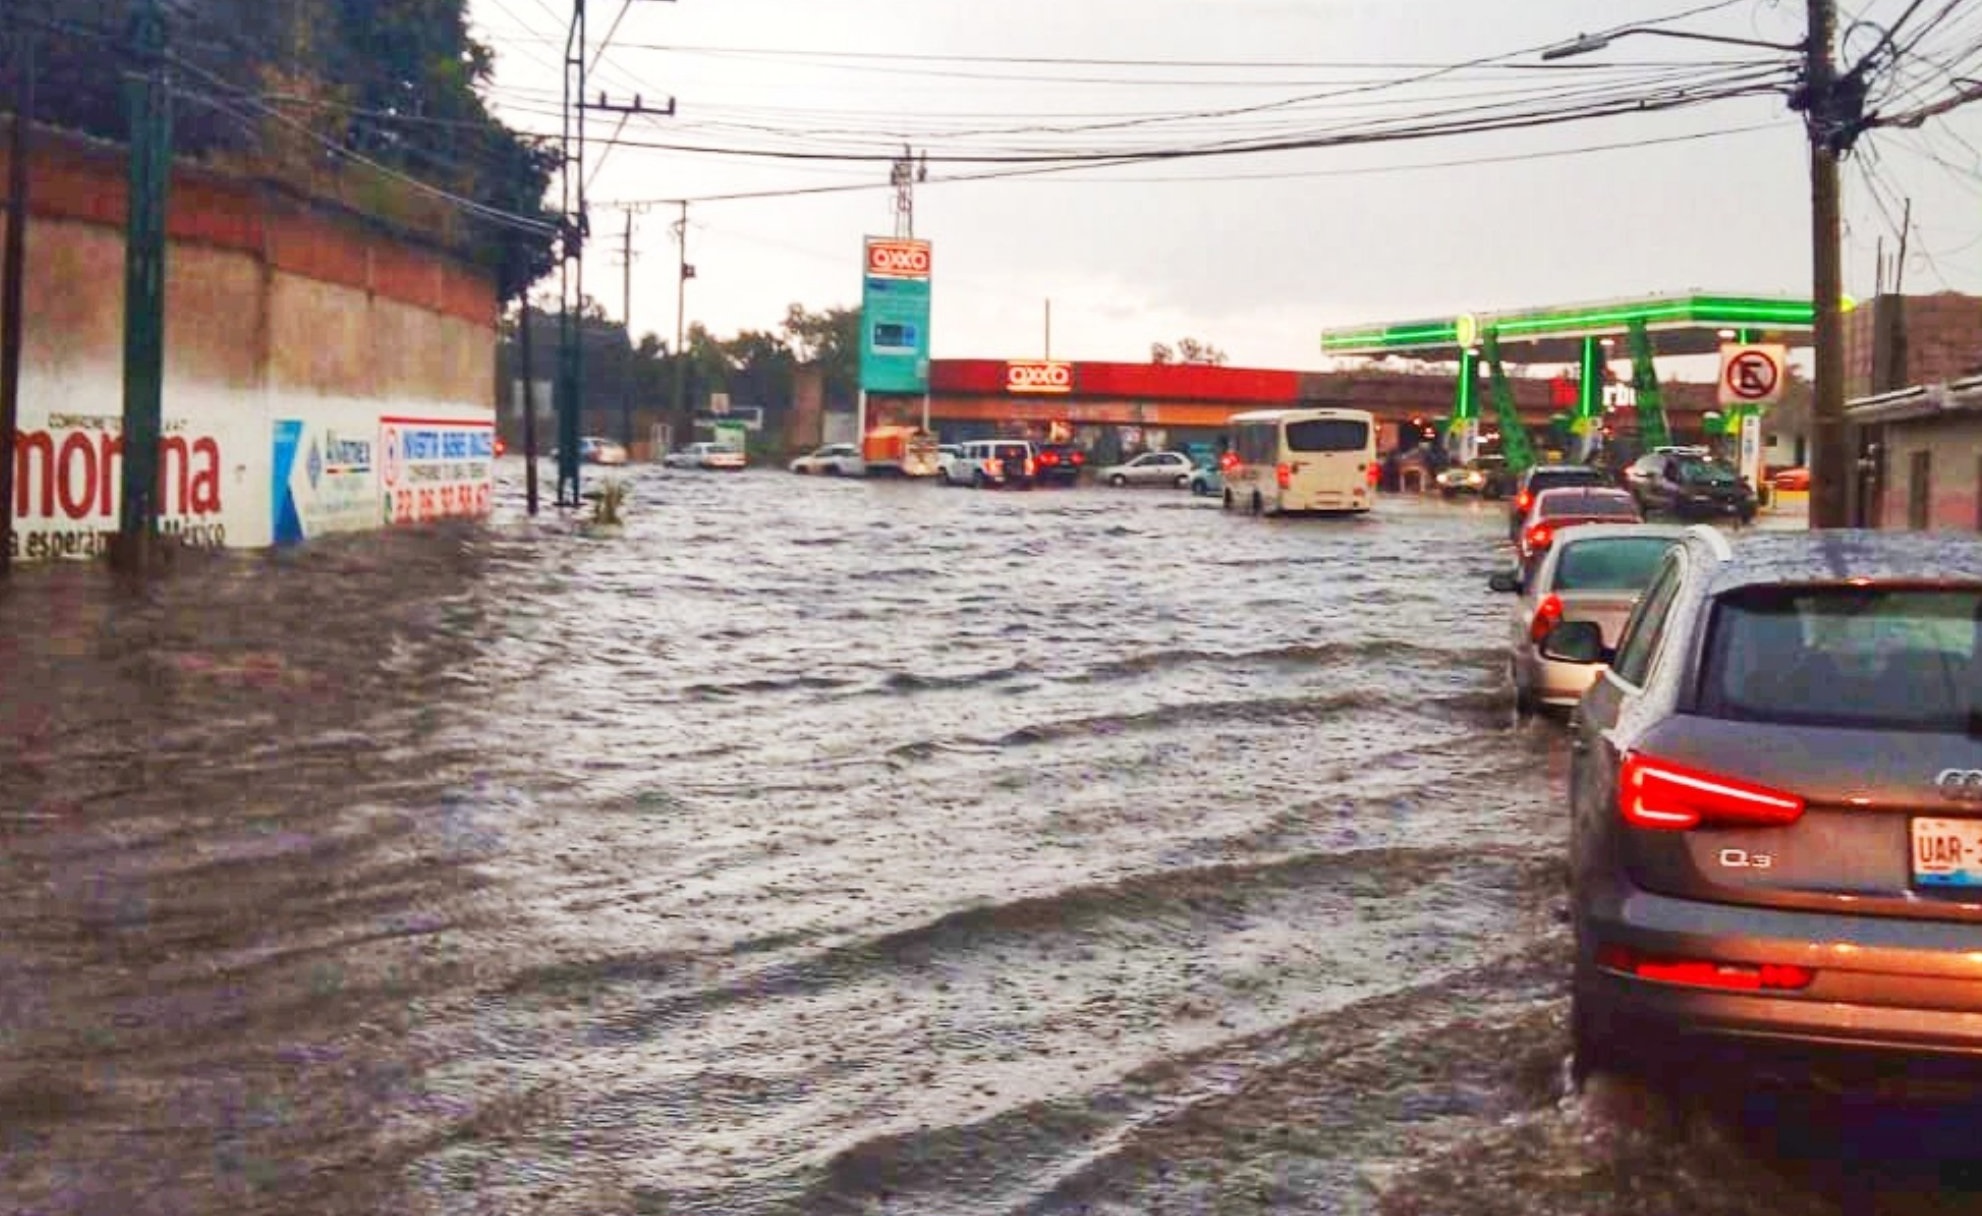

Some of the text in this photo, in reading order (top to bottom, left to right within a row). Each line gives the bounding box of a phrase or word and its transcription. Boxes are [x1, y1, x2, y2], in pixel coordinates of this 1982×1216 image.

[872, 247, 927, 270] OXXO
[1008, 366, 1069, 386] OXXO
[12, 429, 222, 520] morna
[1720, 848, 1772, 869] Q3
